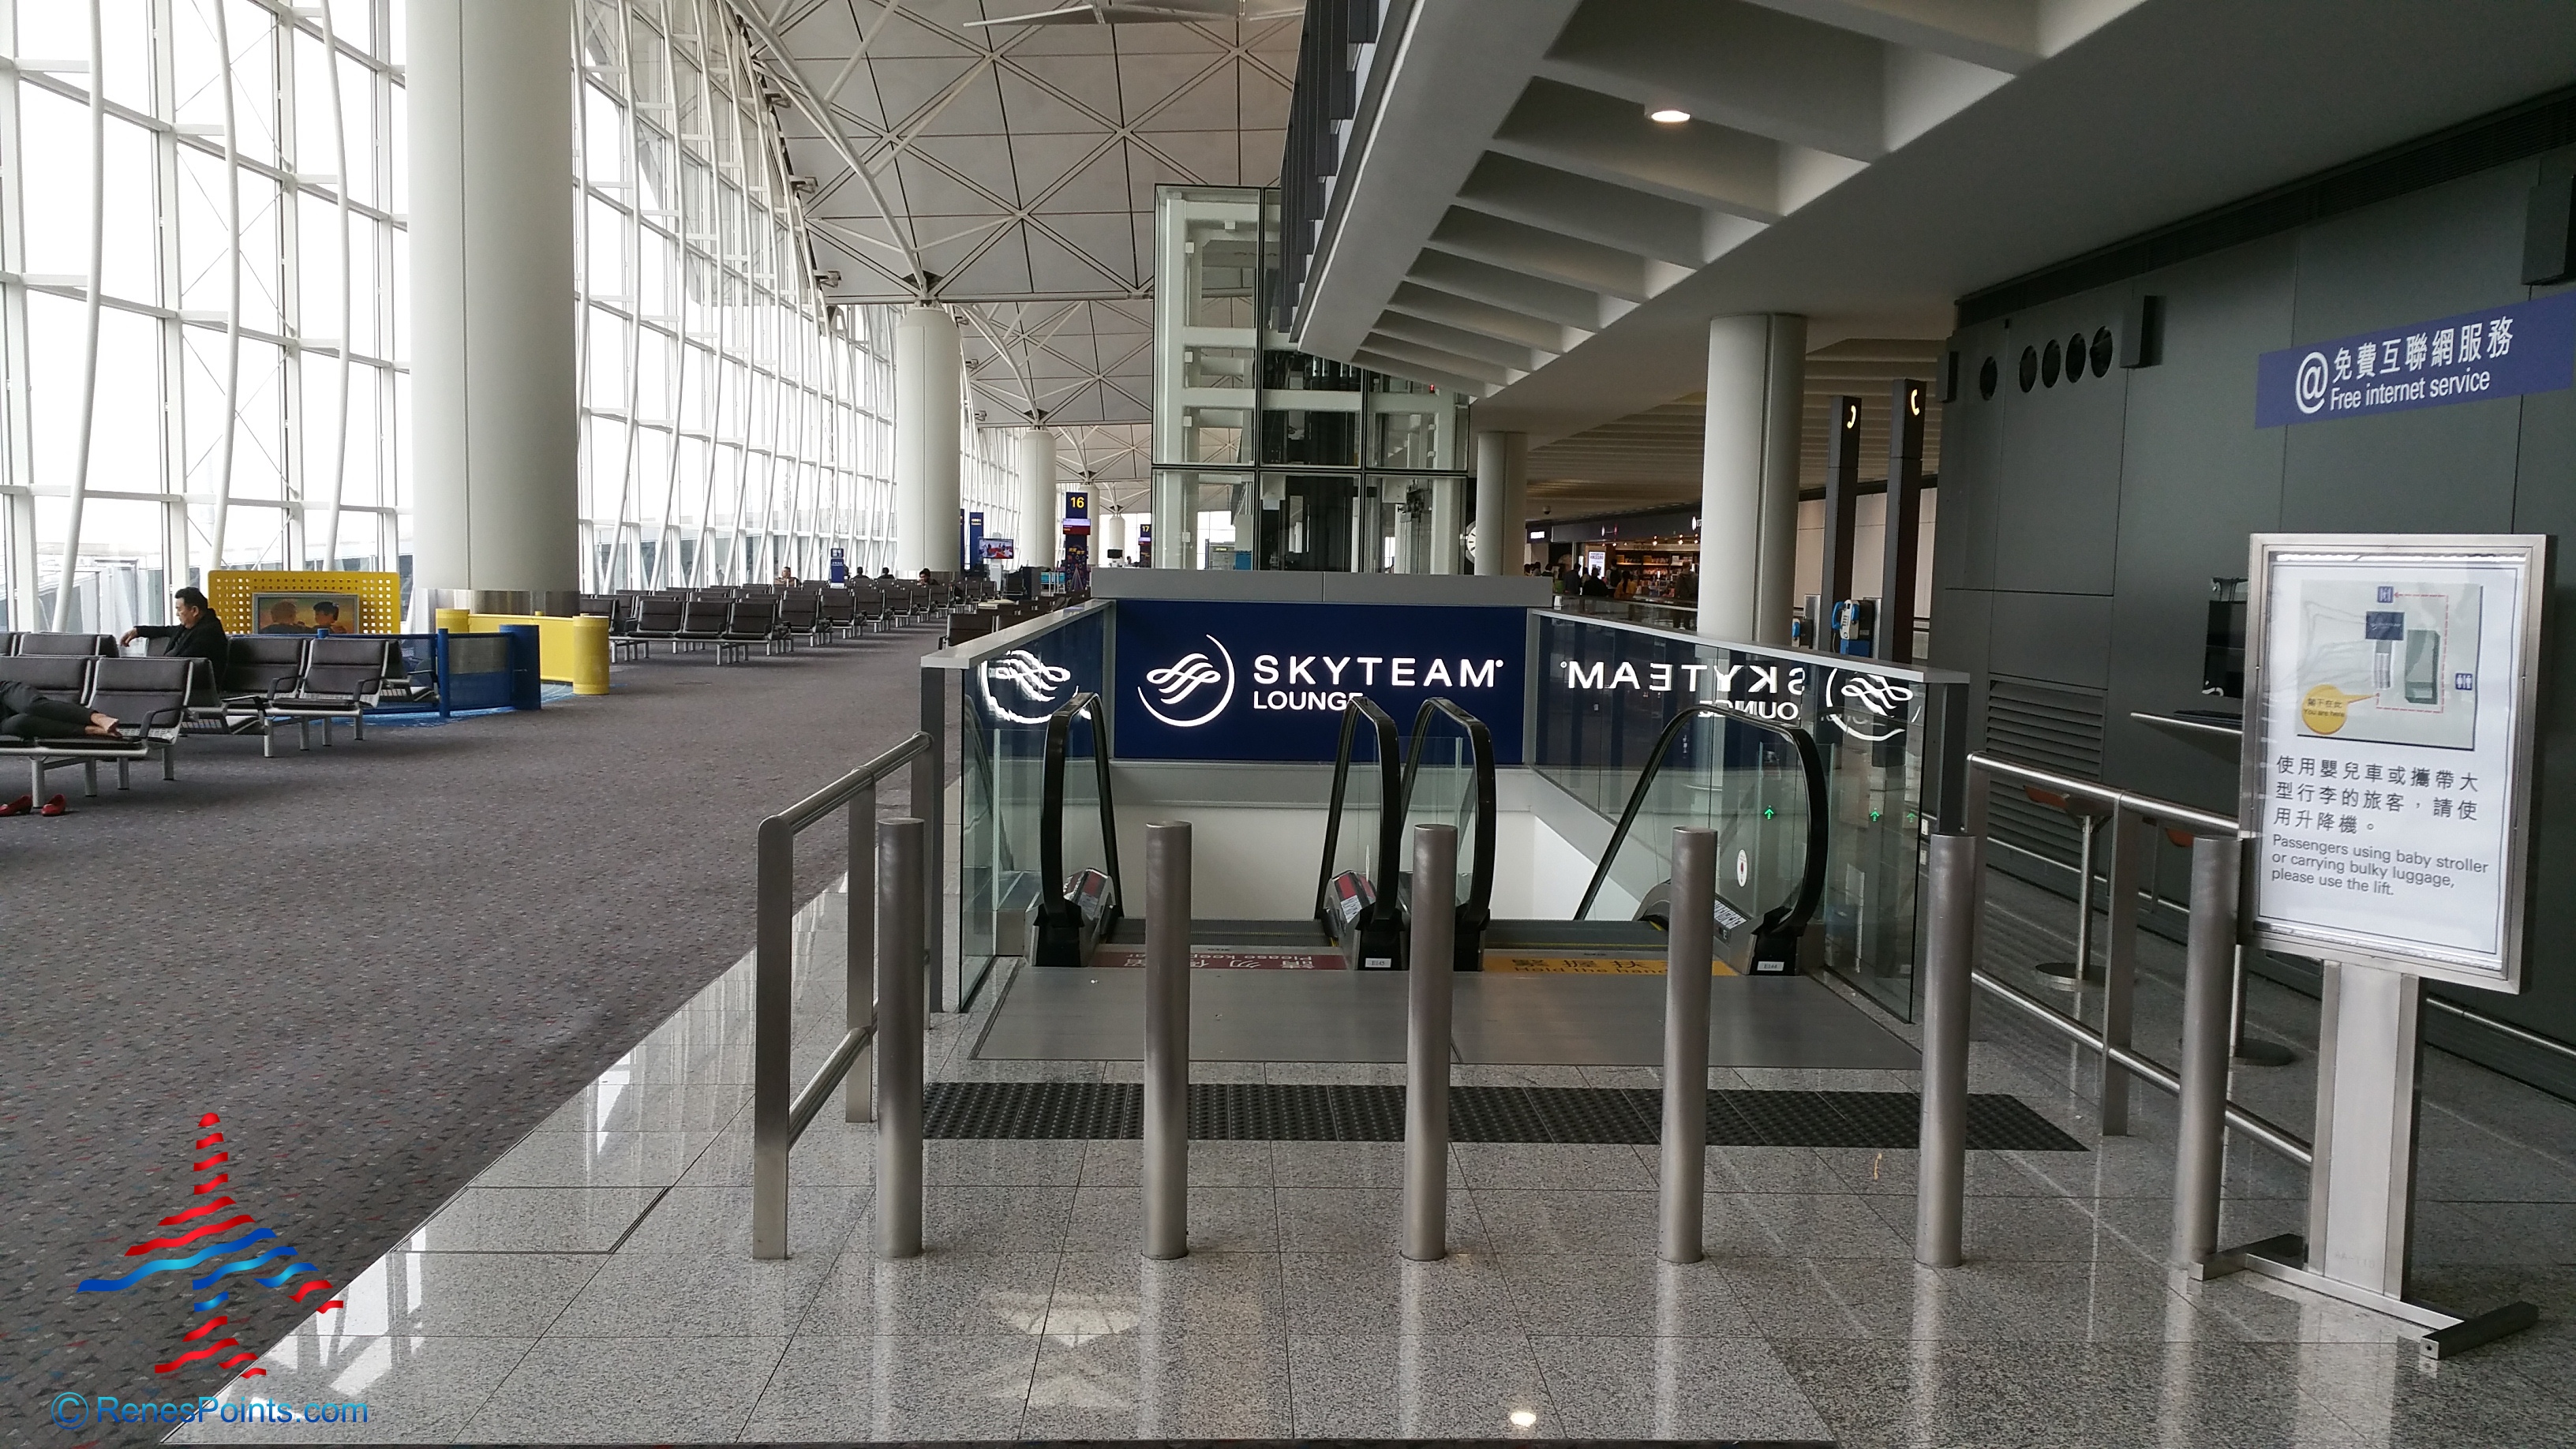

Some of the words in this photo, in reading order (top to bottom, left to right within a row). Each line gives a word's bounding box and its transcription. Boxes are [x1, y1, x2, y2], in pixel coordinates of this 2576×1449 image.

[2332, 316, 2514, 384] 免費互聯網服務
[2330, 387, 2361, 411] Free
[2364, 377, 2426, 406] internet
[2429, 367, 2491, 399] service
[1070, 496, 1084, 508] 16
[1252, 654, 1496, 688] SKYTEAM
[2275, 754, 2479, 792] 使用嬰兒車或攜帶大
[2275, 781, 2478, 822] 型行李的旅客，請使
[2272, 853, 2288, 863] or
[2290, 856, 2346, 874] carrying
[2349, 860, 2388, 879] bulky
[2393, 866, 2455, 889] luggage,
[2273, 834, 2349, 855] Passengers
[2353, 846, 2391, 863] using
[2396, 849, 2432, 868] baby
[2436, 857, 2489, 874] stroller
[2271, 869, 2315, 885] please
[2319, 875, 2343, 889] use
[2347, 878, 2369, 893] the
[2373, 881, 2394, 896] lift.
[1512, 959, 1668, 968] 緊握扶
